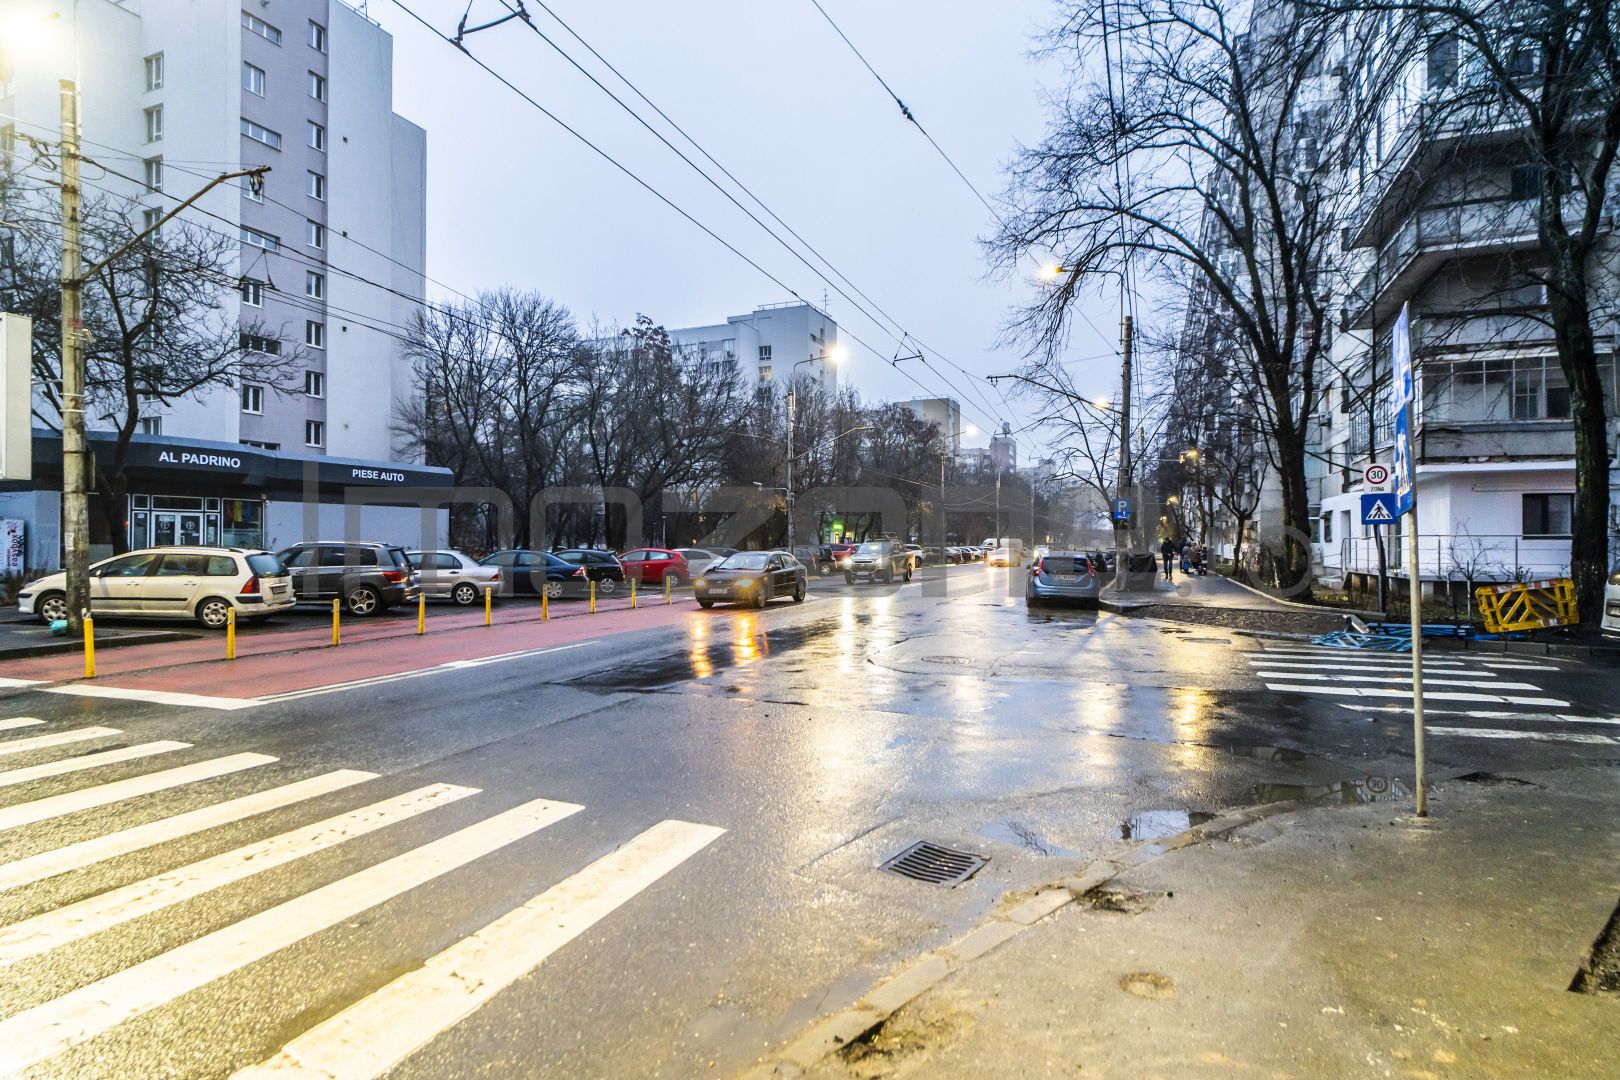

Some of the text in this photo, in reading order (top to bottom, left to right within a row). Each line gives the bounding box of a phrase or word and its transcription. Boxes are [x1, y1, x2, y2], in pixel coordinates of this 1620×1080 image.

[158, 451, 241, 468] AL PADRINO
[352, 469, 405, 482] PIESE AUTO
[1371, 470, 1382, 479] 30
[1118, 500, 1127, 512] P
[10, 534, 18, 567] easybox
